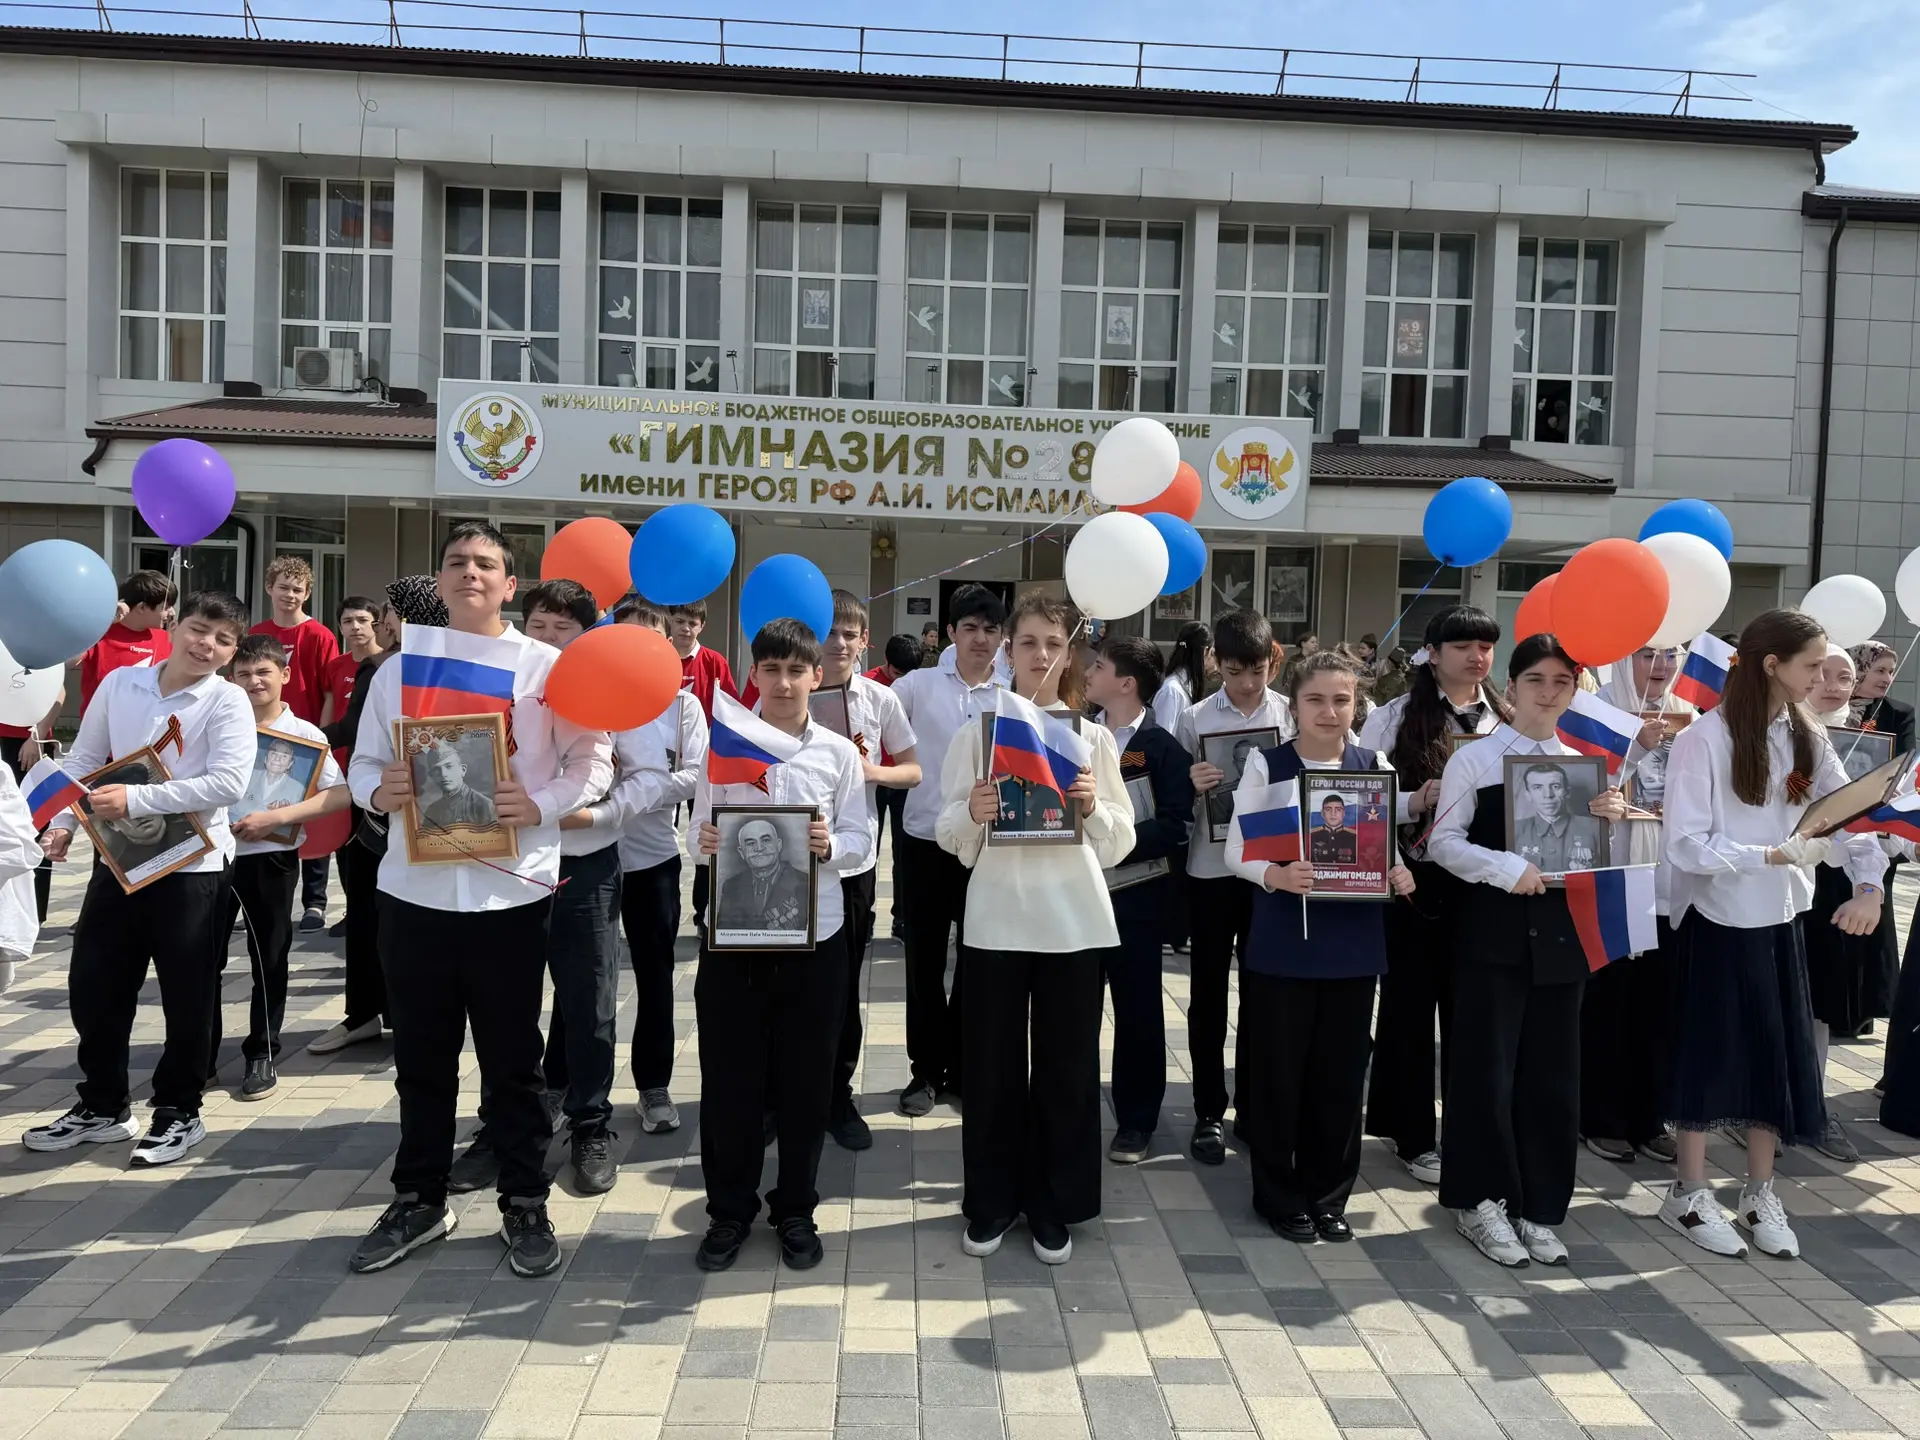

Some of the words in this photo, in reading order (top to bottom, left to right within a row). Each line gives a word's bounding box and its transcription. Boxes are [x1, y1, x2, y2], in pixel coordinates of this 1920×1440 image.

[541, 393, 720, 417] МУНИЦИПАЛЬНОЕ
[725, 402, 846, 424] БЮДЖЕТНОЕ
[851, 409, 1084, 435] ОБЩЕОБРАЗОВАТЕЛЬНОЕ
[1089, 419, 1211, 439] УЧЕНИЕ
[580, 473, 685, 498] имени
[699, 473, 797, 503] ГЕРОЯ
[811, 478, 856, 506] РФ
[867, 481, 932, 509] А.И.
[1335, 779, 1365, 789] РОССИИ
[1366, 780, 1383, 790] ВДВ
[1312, 870, 1382, 881] АДЖИМАГОМЕДОВ
